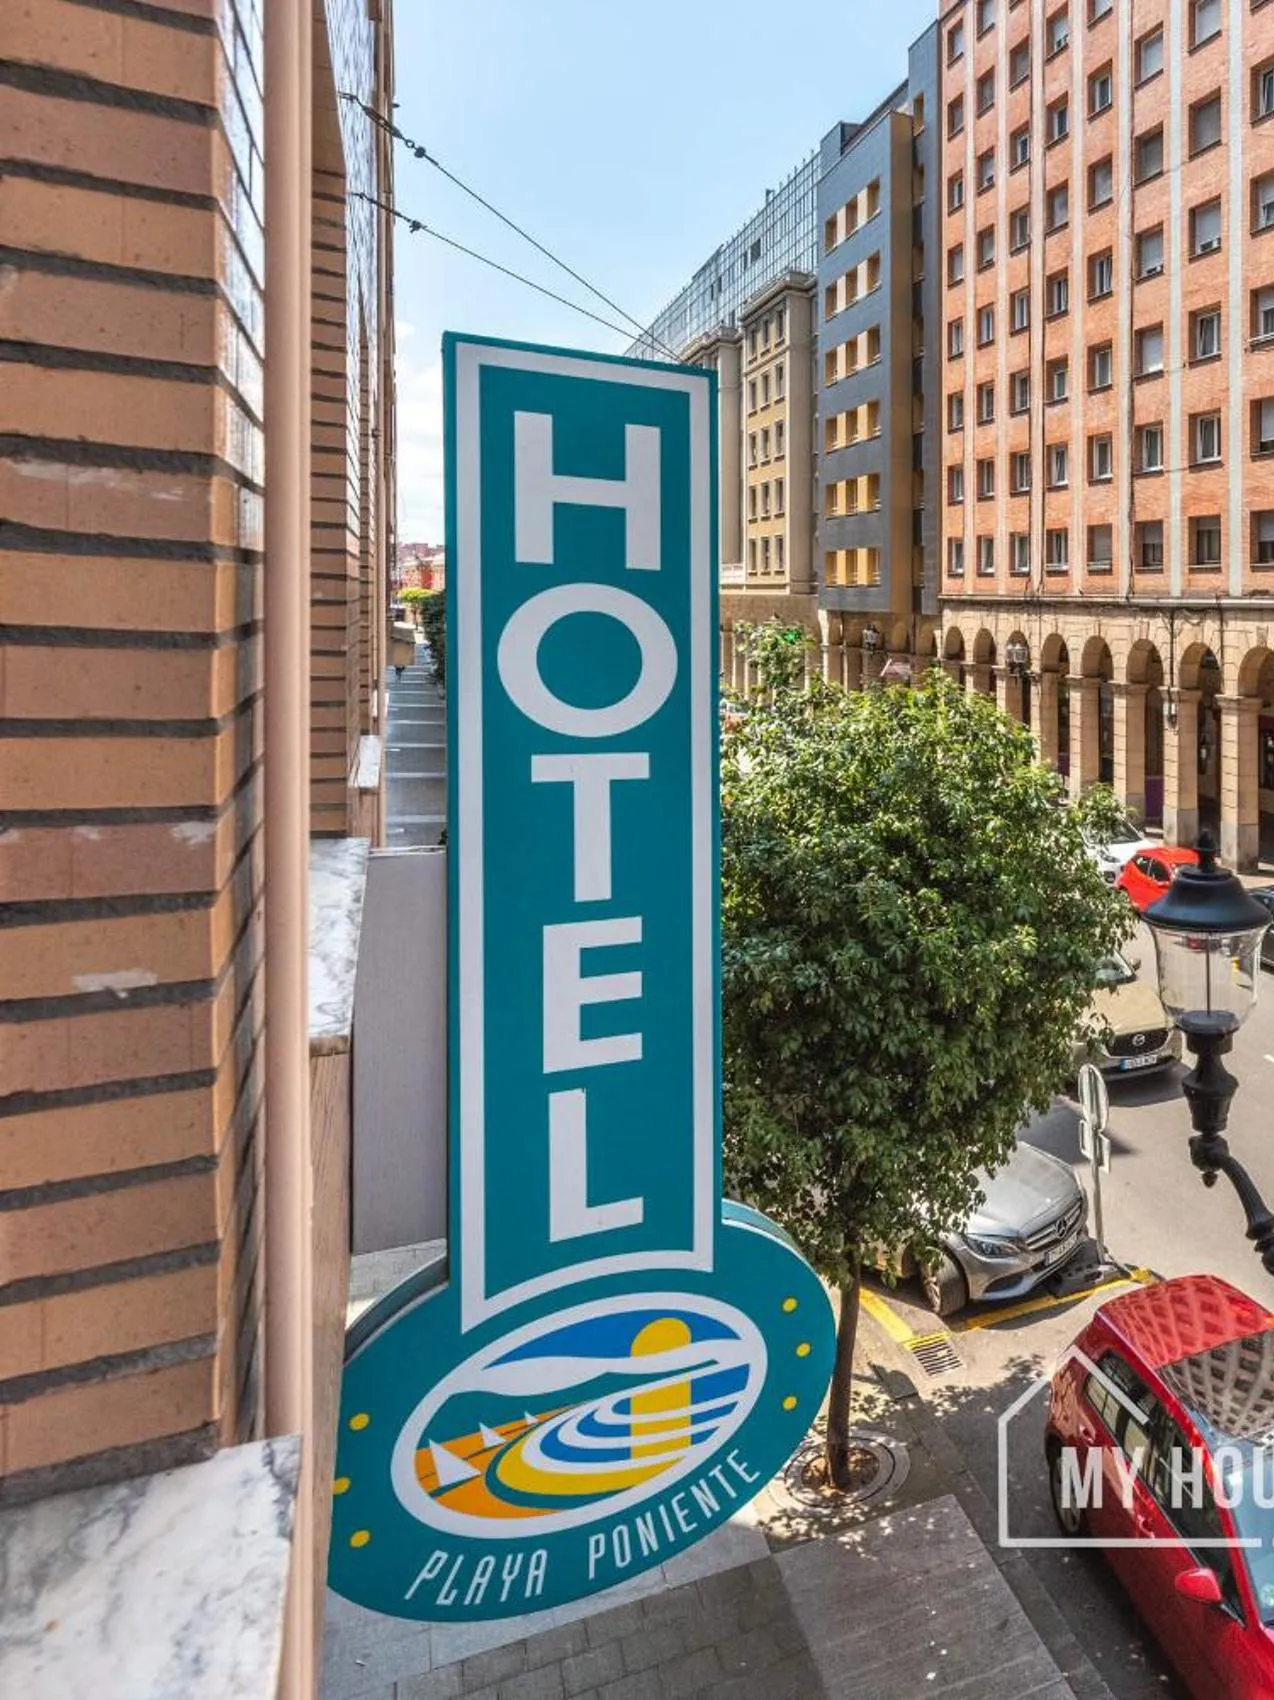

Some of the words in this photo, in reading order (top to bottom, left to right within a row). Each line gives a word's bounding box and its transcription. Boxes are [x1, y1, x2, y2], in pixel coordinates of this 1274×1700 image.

[497, 411, 678, 1243] HOTEL
[405, 1548, 548, 1606] PLAYA
[588, 1448, 760, 1580] PONIENTE
